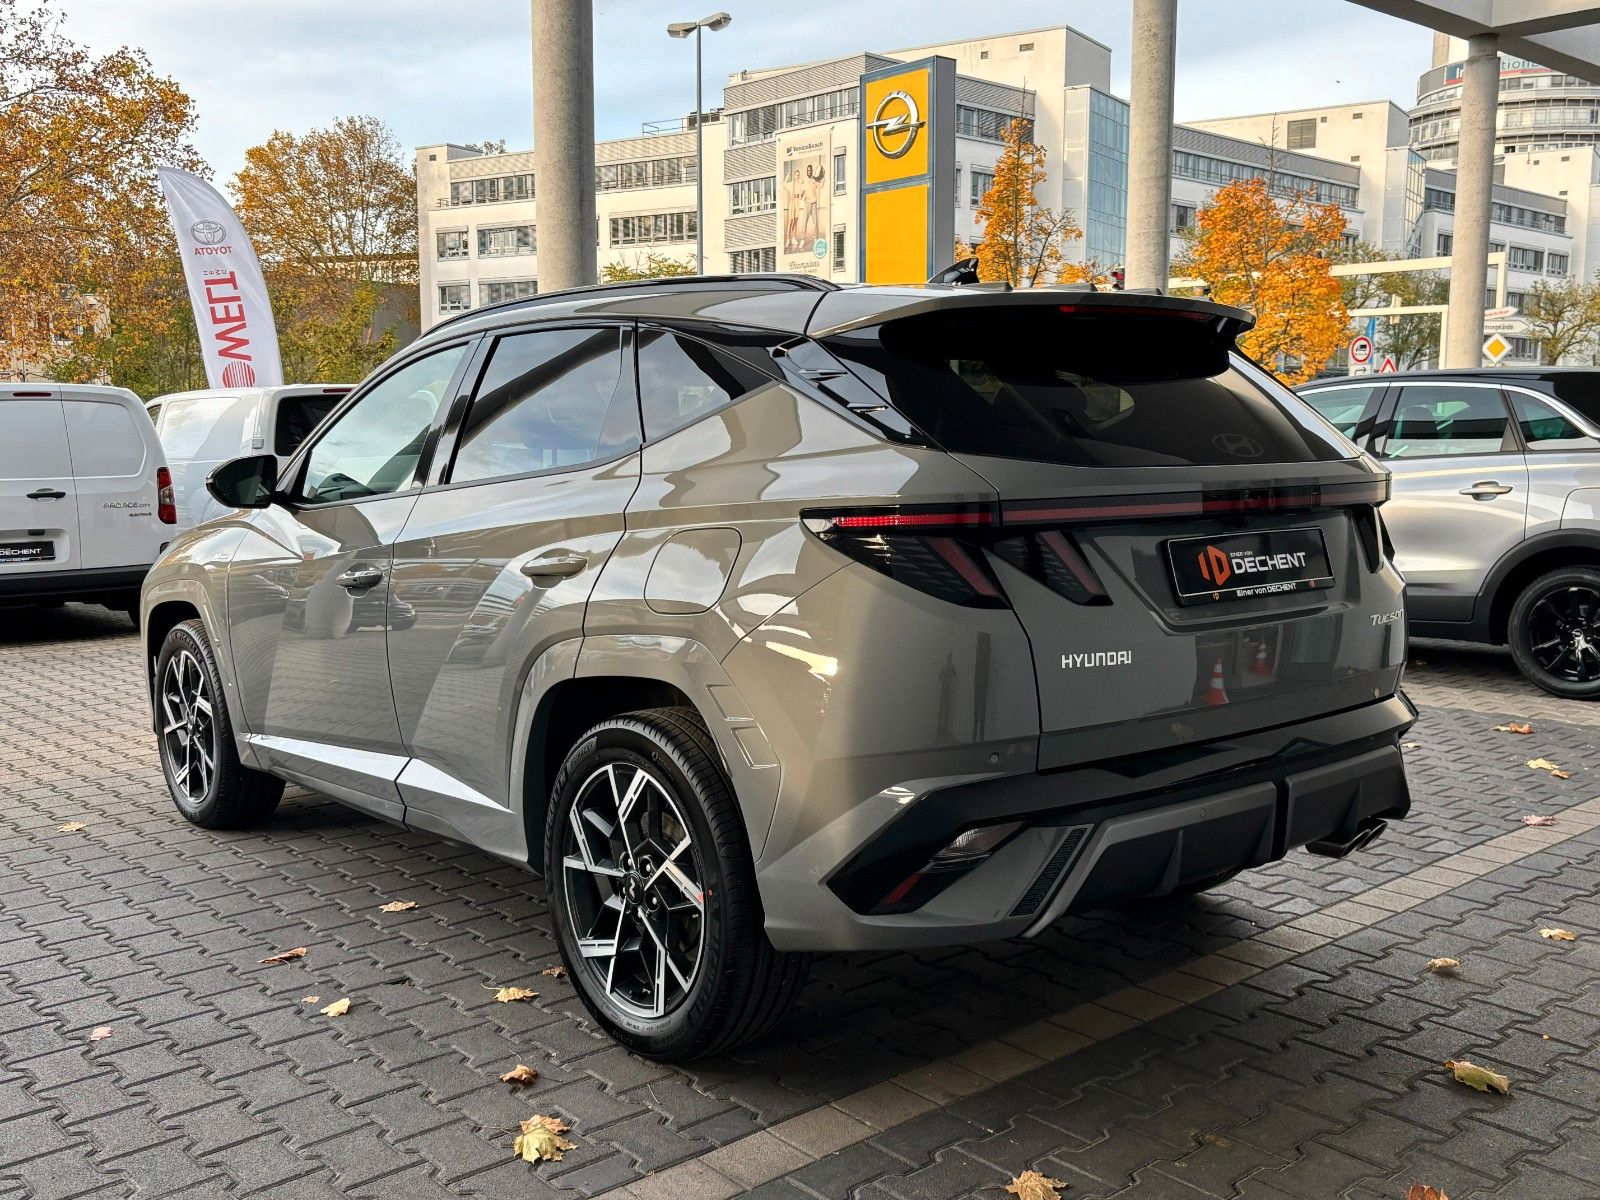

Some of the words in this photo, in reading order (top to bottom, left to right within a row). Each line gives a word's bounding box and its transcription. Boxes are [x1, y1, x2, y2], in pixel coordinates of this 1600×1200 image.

[1231, 552, 1306, 575] DECHENT
[1236, 589, 1254, 597] Einer
[1255, 587, 1267, 595] von
[1267, 583, 1297, 593] DECHENT
[1061, 650, 1131, 669] HYUNDAI
